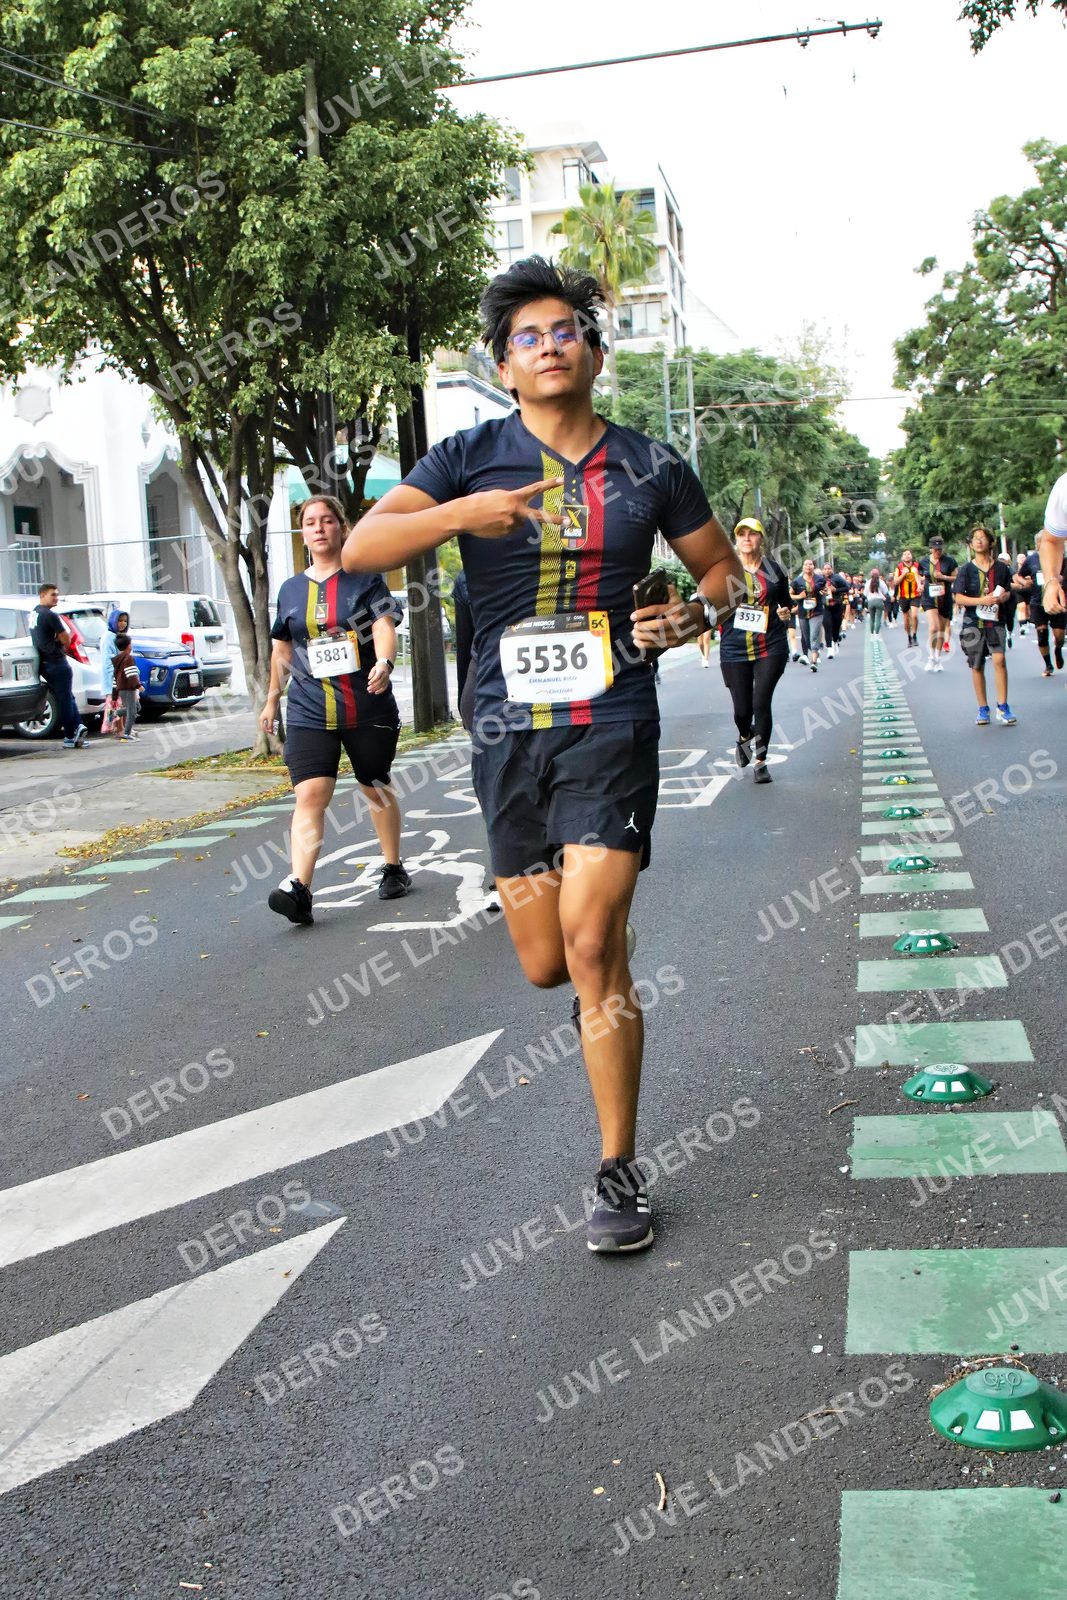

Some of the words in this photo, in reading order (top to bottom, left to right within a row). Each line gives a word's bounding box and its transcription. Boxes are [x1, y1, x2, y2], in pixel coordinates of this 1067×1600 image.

[739, 611, 762, 623] 3537
[315, 646, 348, 664] 5881
[516, 642, 588, 674] 5536
